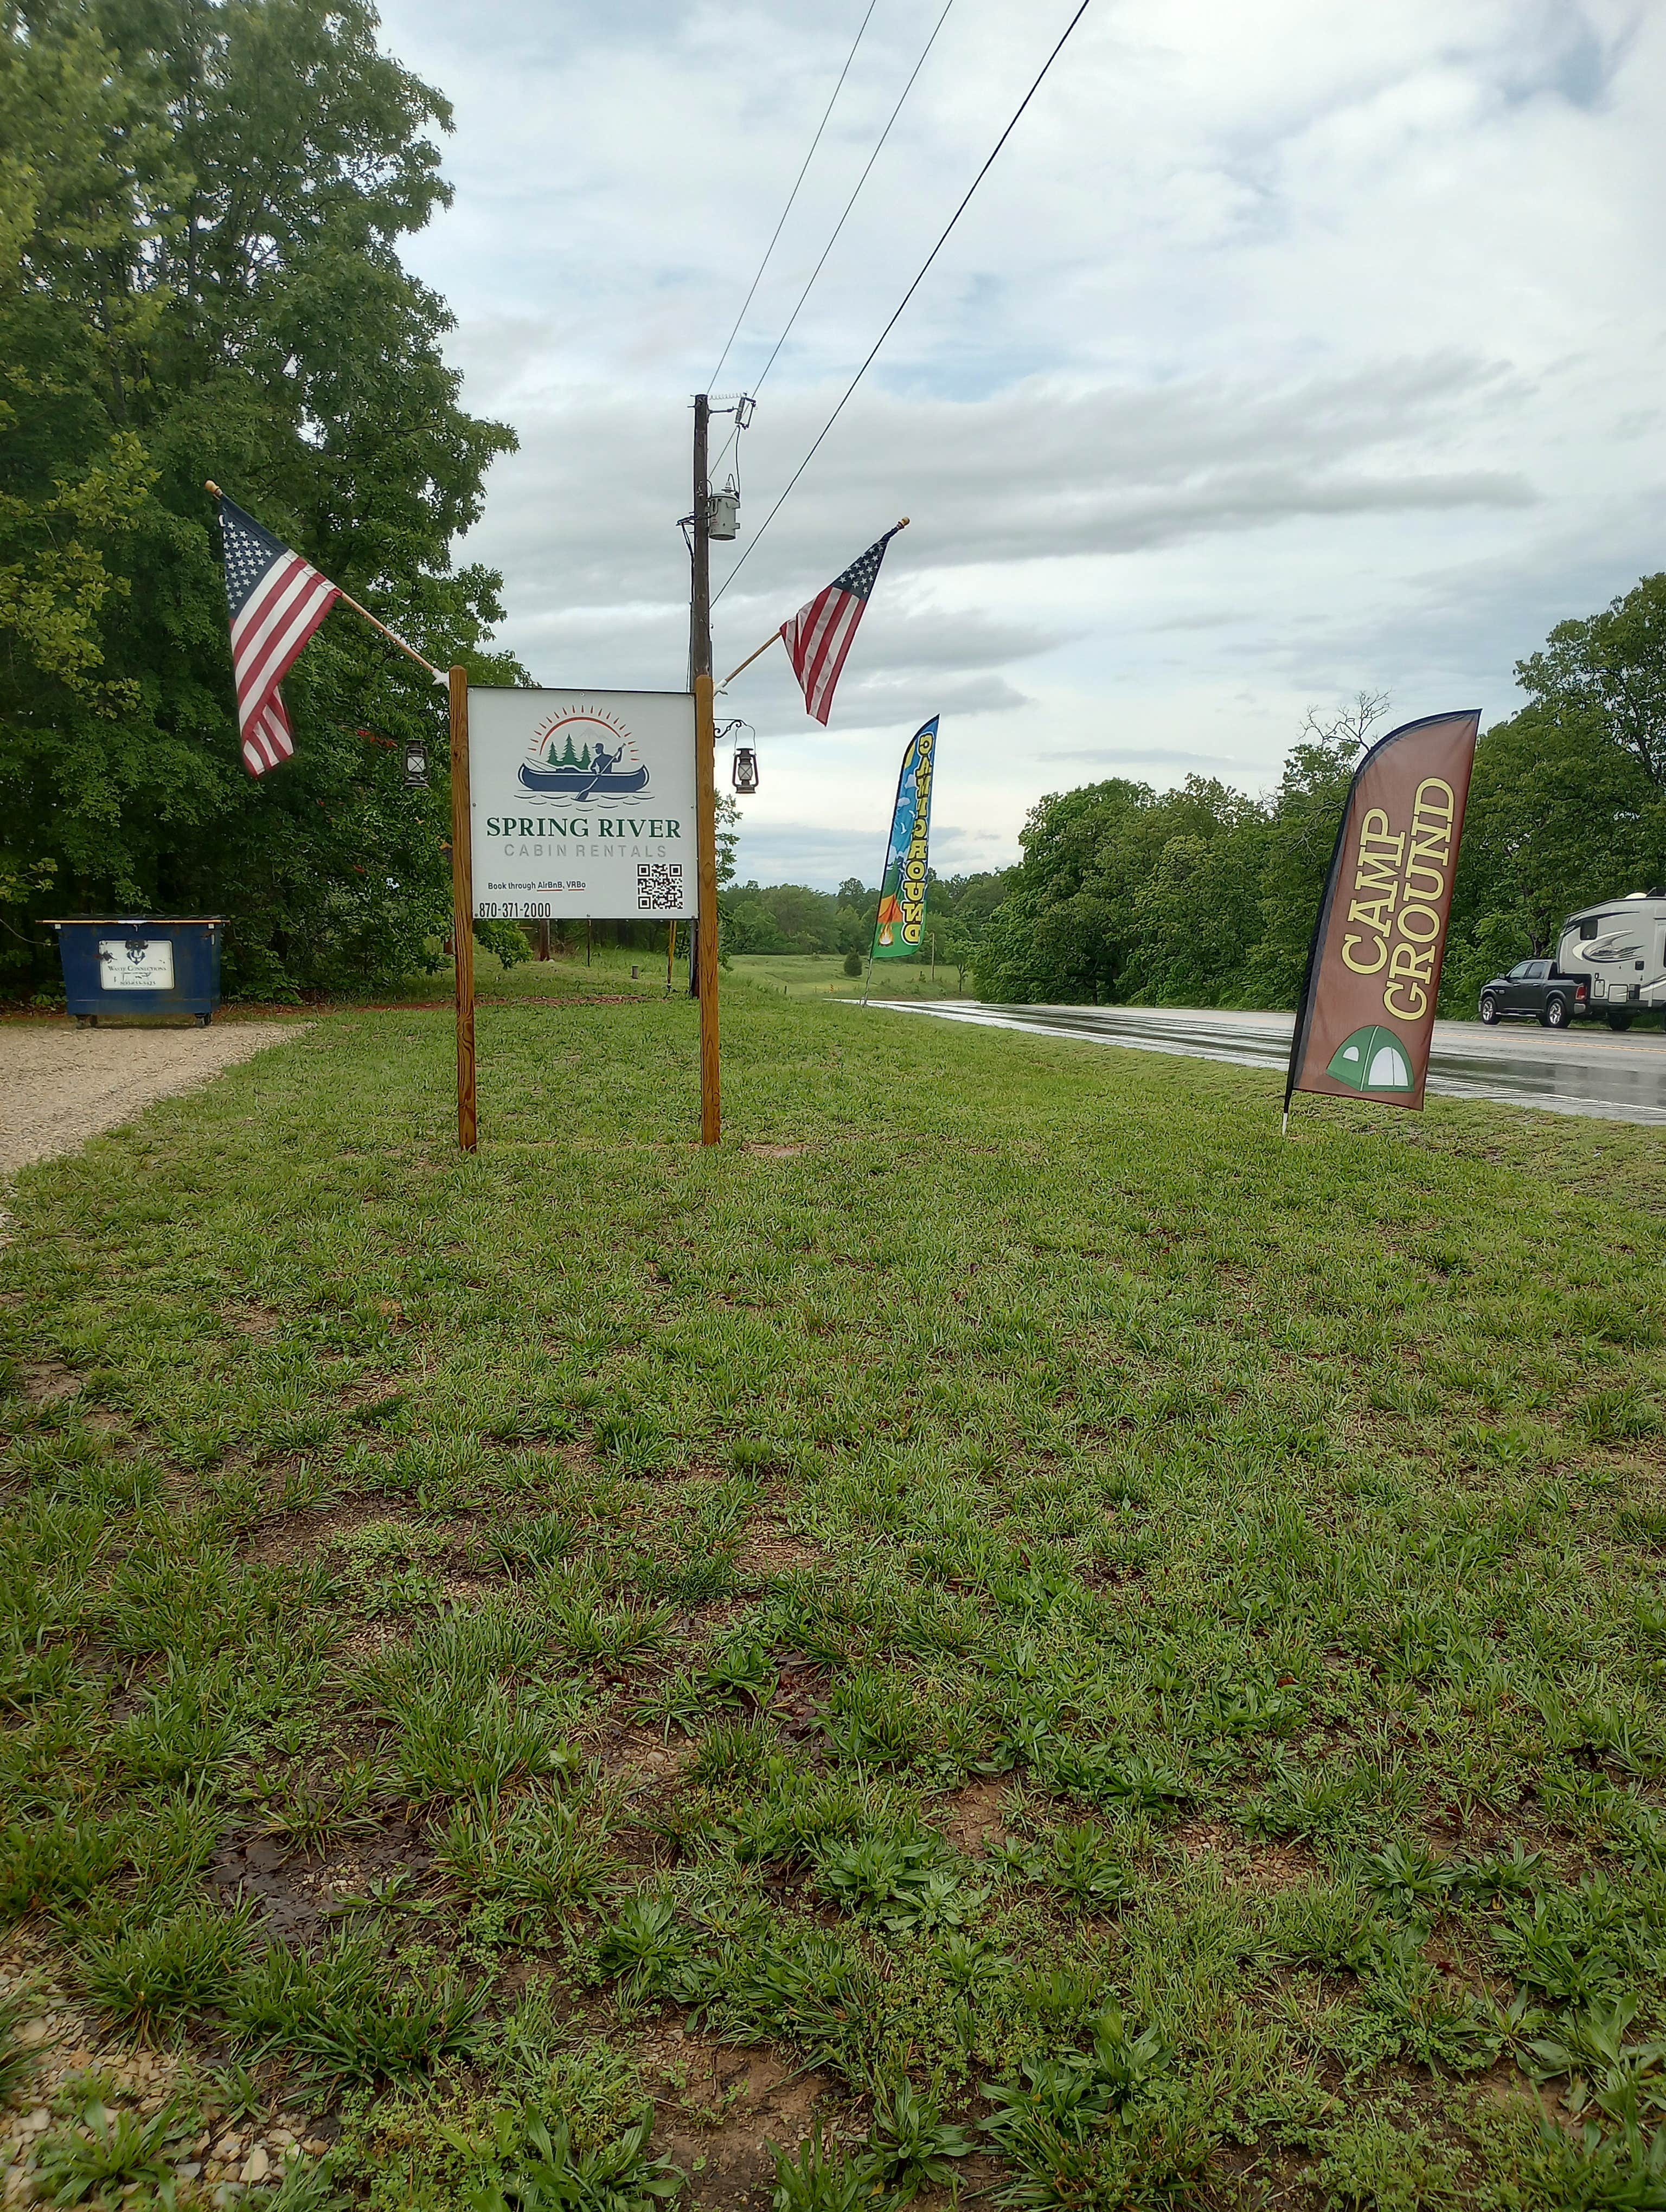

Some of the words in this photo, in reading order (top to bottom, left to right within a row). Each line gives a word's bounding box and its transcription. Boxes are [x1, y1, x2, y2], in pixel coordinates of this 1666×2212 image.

[486, 817, 589, 837] SPRING
[598, 819, 681, 838] RIVER
[504, 844, 567, 857] CABIN
[575, 845, 667, 858] RENTALS
[508, 882, 536, 890] through
[1341, 807, 1406, 975] CAMP
[1383, 777, 1455, 1021] GROUND
[479, 902, 551, 918] 870-371-2000
